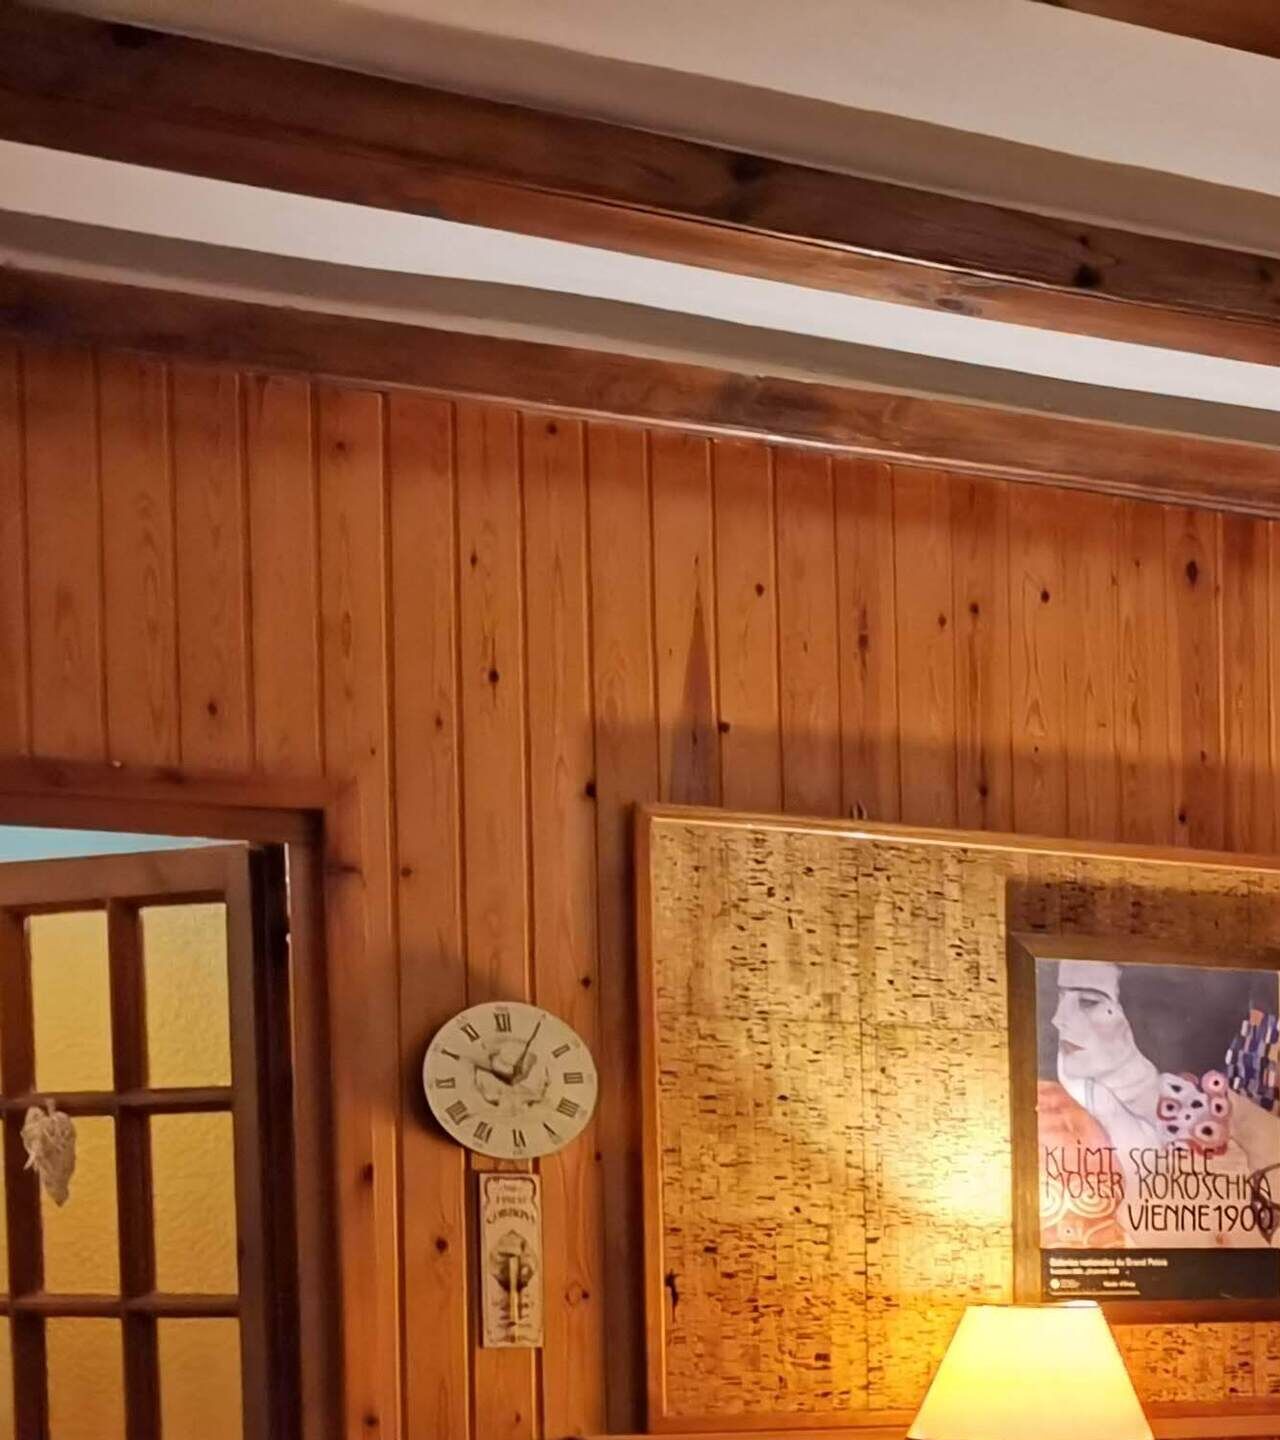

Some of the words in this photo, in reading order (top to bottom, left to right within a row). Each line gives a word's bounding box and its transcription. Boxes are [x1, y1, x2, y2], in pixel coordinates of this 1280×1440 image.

[1045, 1140, 1118, 1176] KLIMT
[1129, 1142, 1214, 1176] SCHIELE
[1045, 1172, 1125, 1200] MOSER
[1138, 1172, 1272, 1200] KOKOSCHKA
